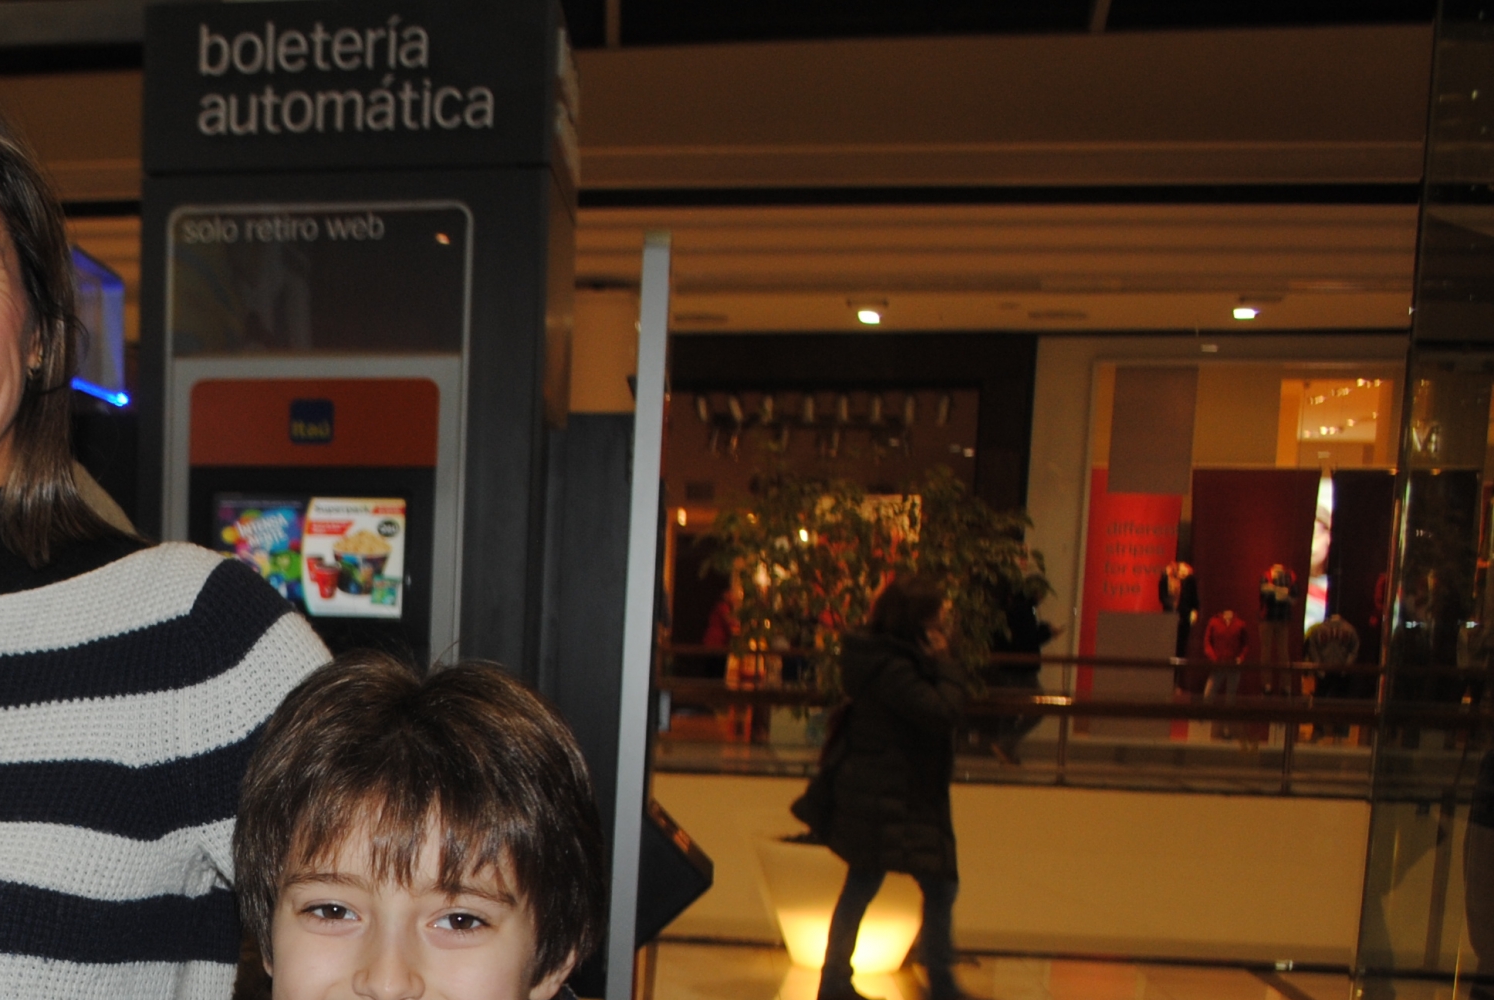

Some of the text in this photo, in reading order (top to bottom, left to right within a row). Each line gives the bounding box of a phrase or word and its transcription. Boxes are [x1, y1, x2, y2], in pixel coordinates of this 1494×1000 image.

[198, 13, 430, 76] boletería
[196, 72, 496, 136] automática
[182, 210, 386, 245] solo retiro web
